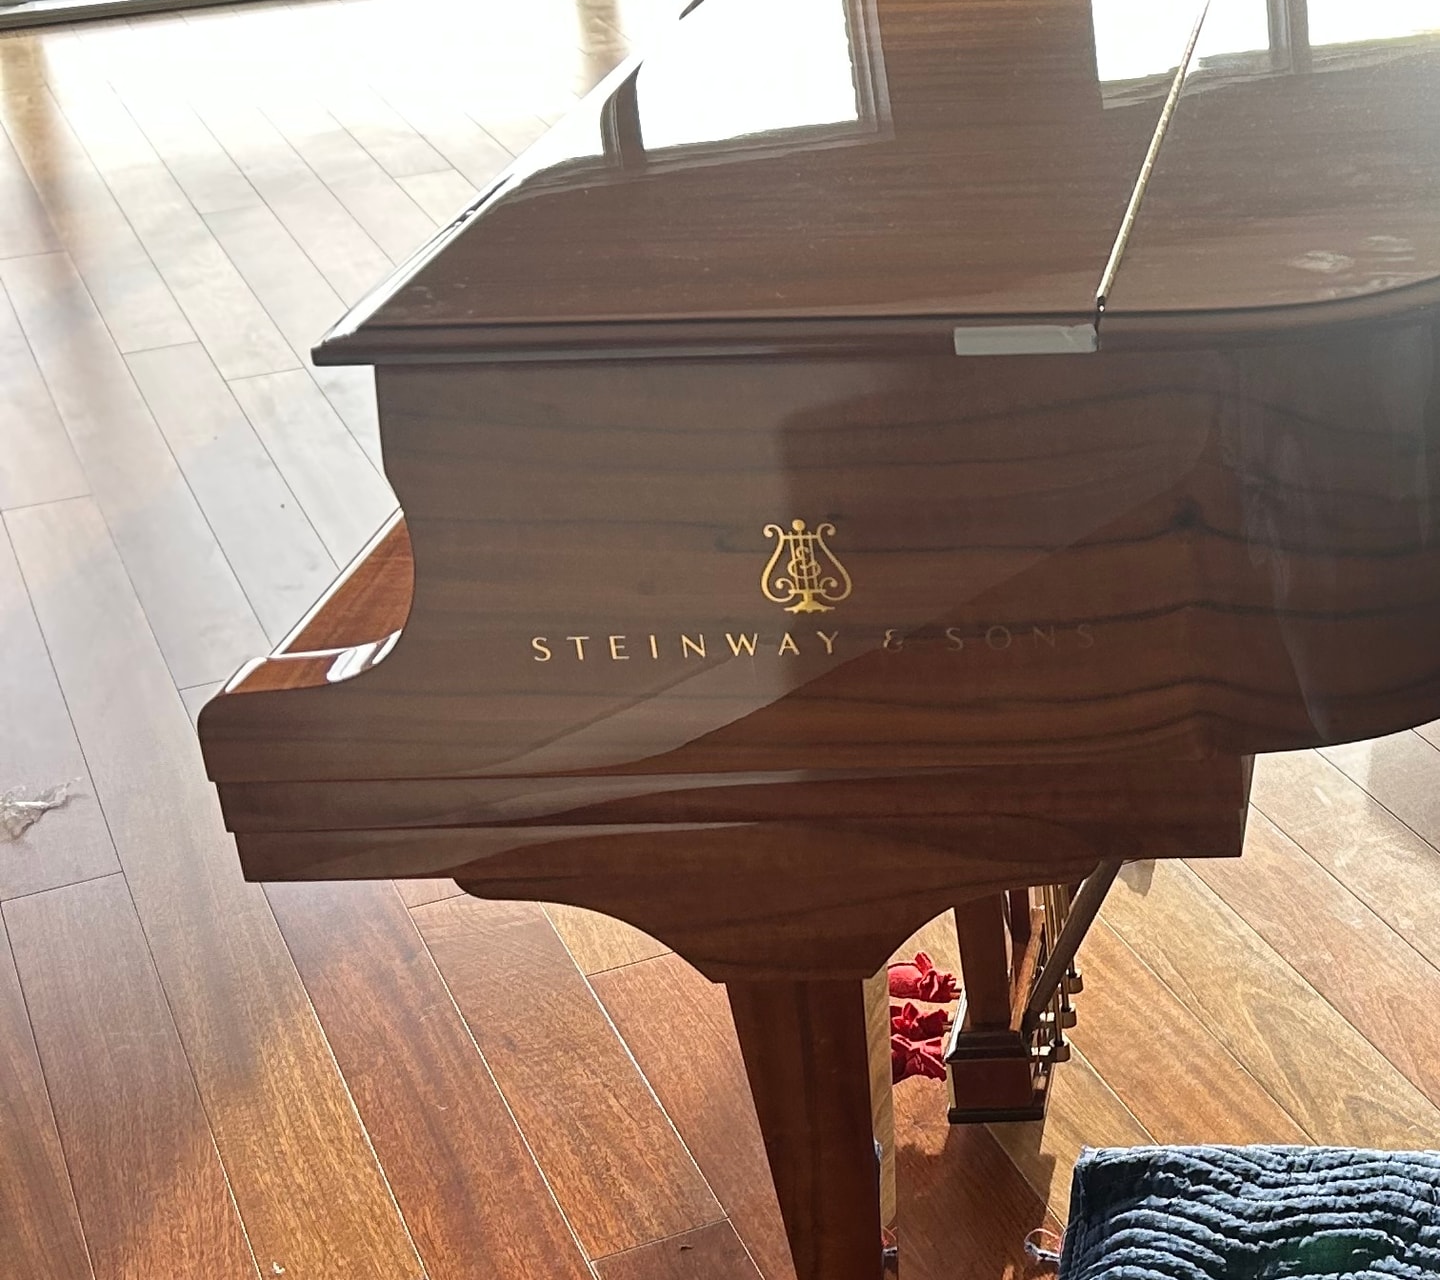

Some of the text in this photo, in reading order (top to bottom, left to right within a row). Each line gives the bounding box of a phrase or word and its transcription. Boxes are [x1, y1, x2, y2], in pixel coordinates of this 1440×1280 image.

[531, 623, 1095, 662] STEINWAY & SONS
